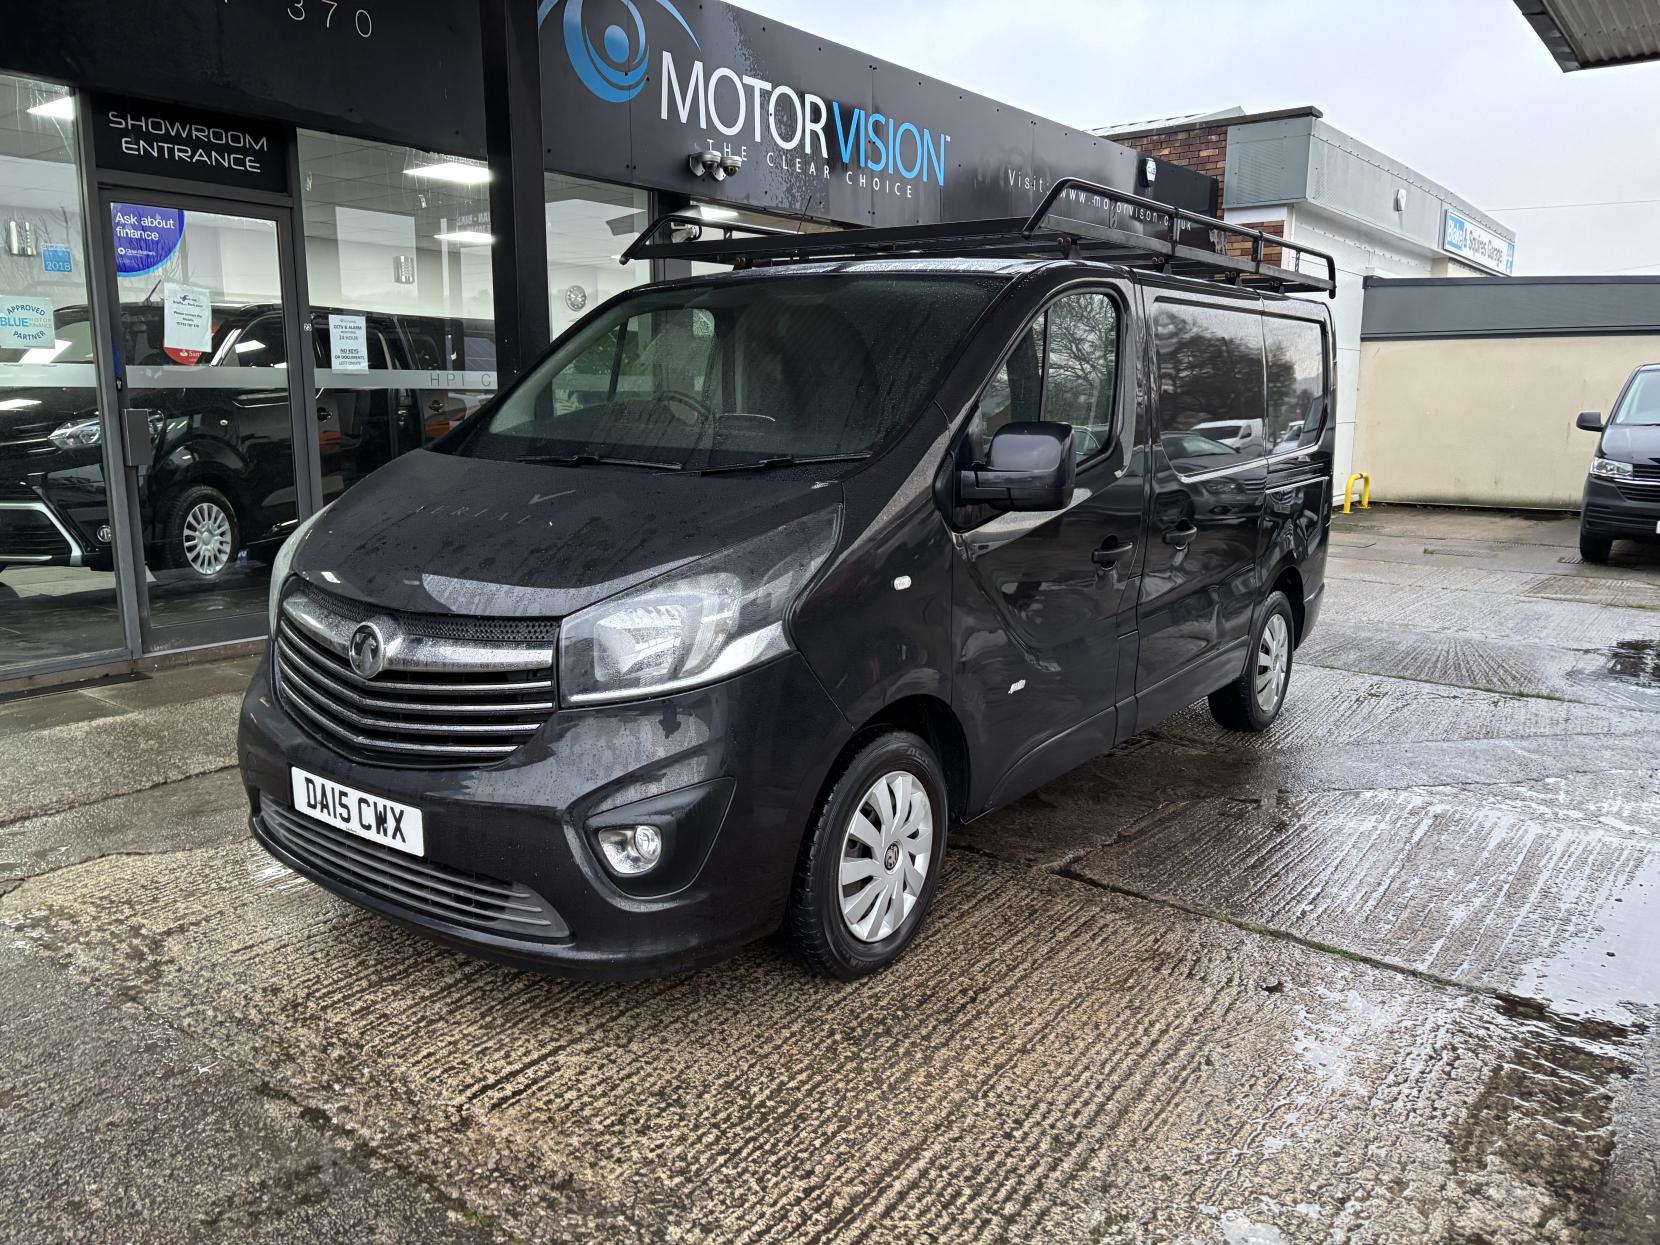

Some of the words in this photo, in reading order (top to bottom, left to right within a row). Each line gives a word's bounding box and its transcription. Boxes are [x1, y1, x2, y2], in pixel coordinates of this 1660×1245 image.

[109, 111, 267, 151] SHOWROOM
[121, 137, 260, 172] ENTRANCE
[706, 139, 747, 160] THE
[767, 152, 830, 179] CLEAR
[846, 171, 912, 198] CHOICE
[115, 212, 138, 225] Ask
[141, 215, 174, 229] about
[116, 226, 159, 240] finance
[1469, 230, 1486, 257] Squires
[1487, 239, 1503, 267] Garage
[47, 261, 70, 271] 2018
[7, 304, 45, 316] APPROVED
[0, 316, 29, 327] BLUE
[13, 330, 46, 341] PARTNER
[430, 373, 465, 386] HPI
[304, 776, 351, 824] DA15
[358, 797, 406, 843] CWX
